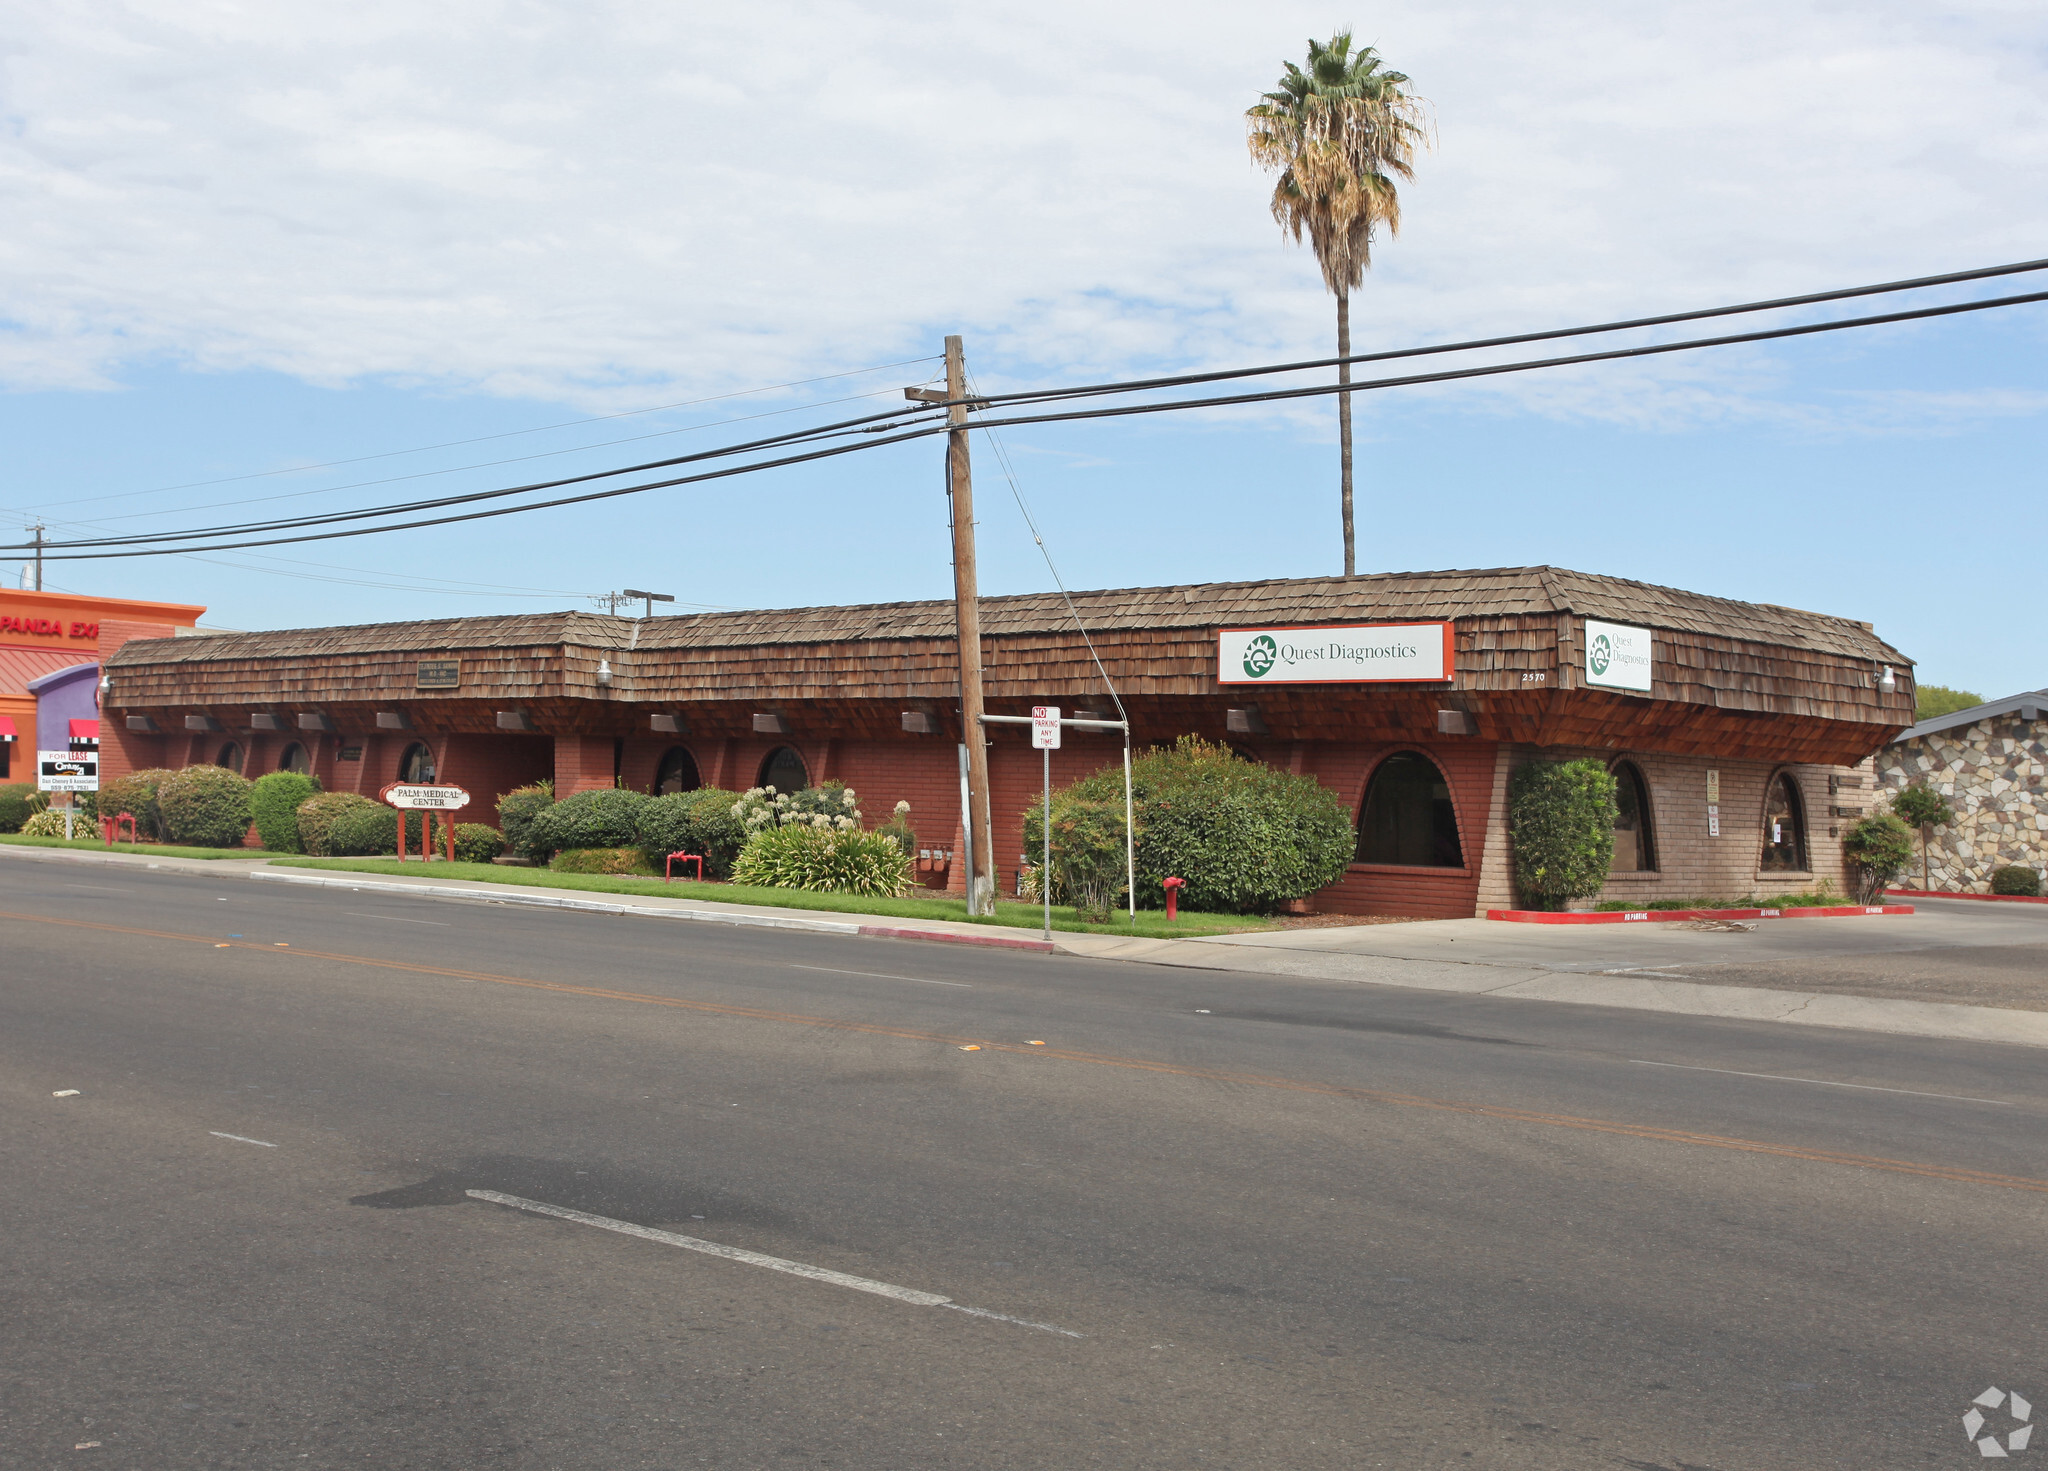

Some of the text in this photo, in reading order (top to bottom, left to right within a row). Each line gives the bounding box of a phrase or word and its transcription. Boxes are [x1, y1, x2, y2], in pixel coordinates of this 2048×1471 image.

[0, 616, 62, 637] PANDA
[1612, 632, 1632, 648] Quest
[1281, 643, 1417, 665] Quest Diagnostics
[1613, 649, 1649, 667] Diagnostics
[1522, 673, 1545, 682] 2570
[1035, 708, 1046, 717] NO
[1035, 720, 1058, 728] PARKING
[68, 751, 88, 761] LEASE
[398, 789, 420, 797] PALM
[413, 798, 445, 806] CENTER
